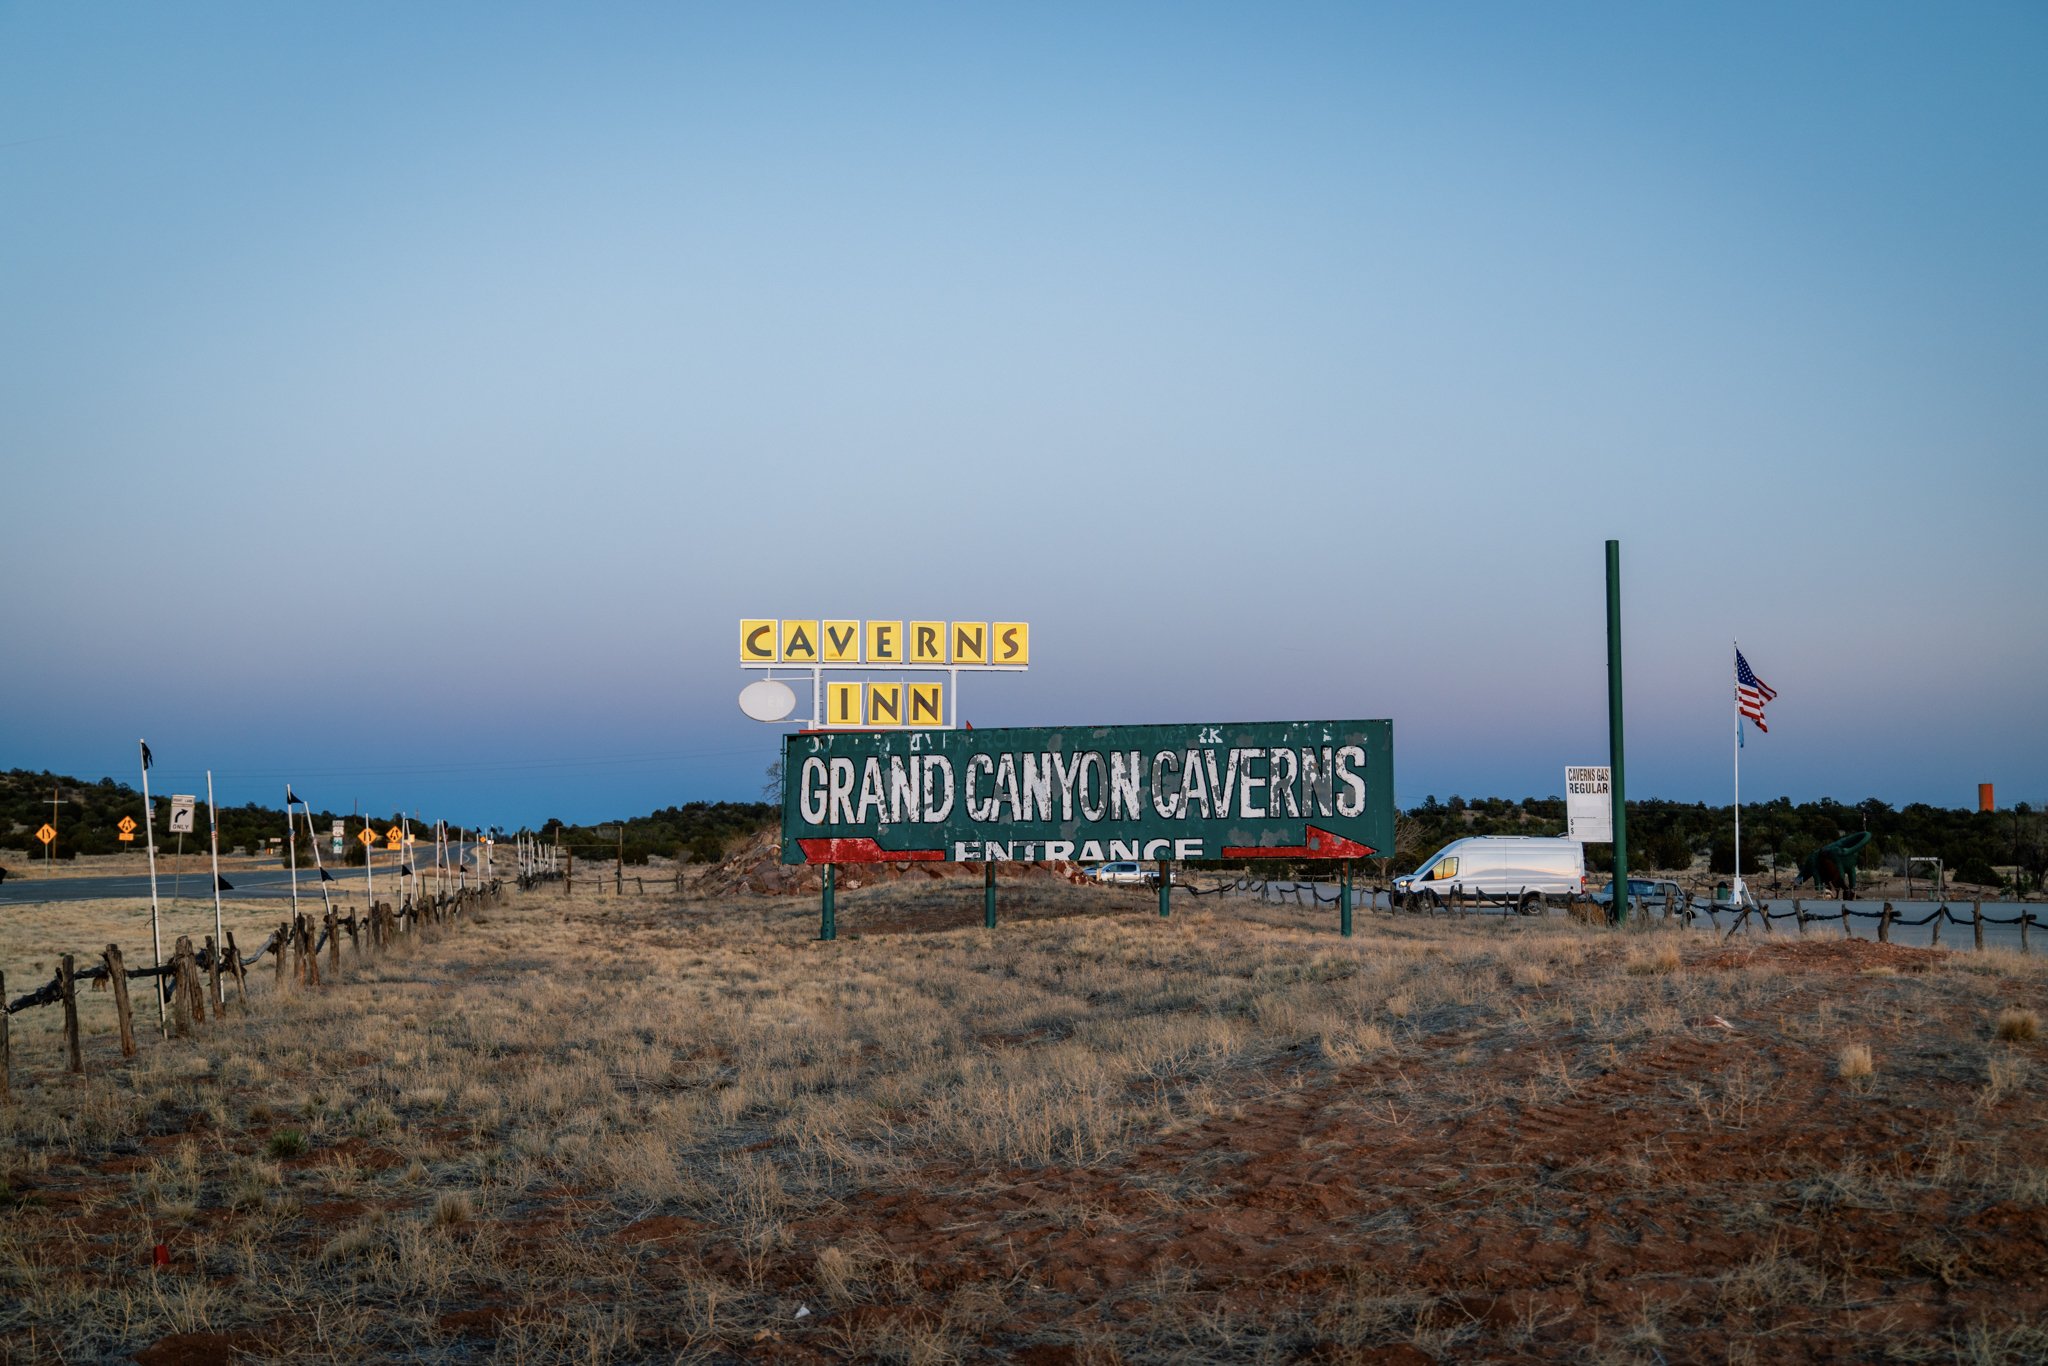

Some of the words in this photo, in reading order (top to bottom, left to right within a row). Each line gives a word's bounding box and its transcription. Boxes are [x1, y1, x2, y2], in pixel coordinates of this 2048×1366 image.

[746, 625, 1019, 659] CAVERNS
[840, 688, 939, 721] INN
[800, 754, 955, 825] GRAND
[965, 750, 1142, 822] CANYON
[1151, 745, 1367, 820] CAVERNS
[1568, 769, 1595, 781] CAVERNS
[1597, 769, 1609, 781] GAS
[1569, 783, 1608, 794] REGULAR
